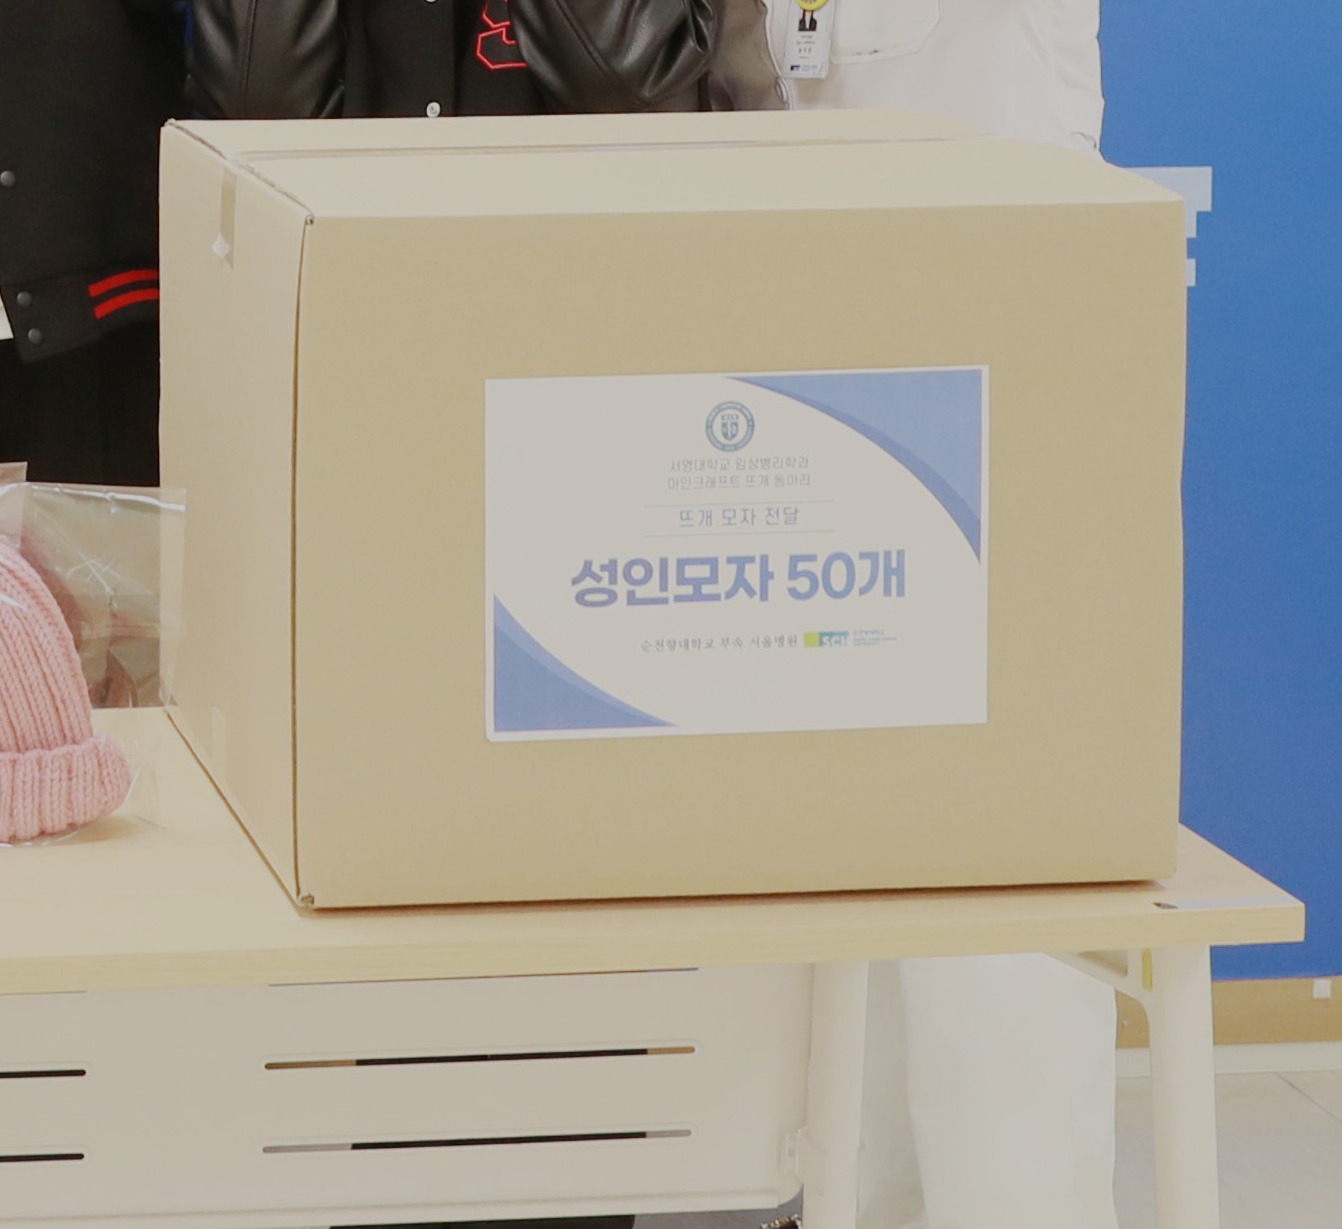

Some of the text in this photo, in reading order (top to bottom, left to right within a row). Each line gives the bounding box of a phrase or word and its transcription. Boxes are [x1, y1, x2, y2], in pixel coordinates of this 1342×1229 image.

[678, 506, 800, 528] 뜨개 모자 전달
[570, 549, 907, 608] 성인모자 50개
